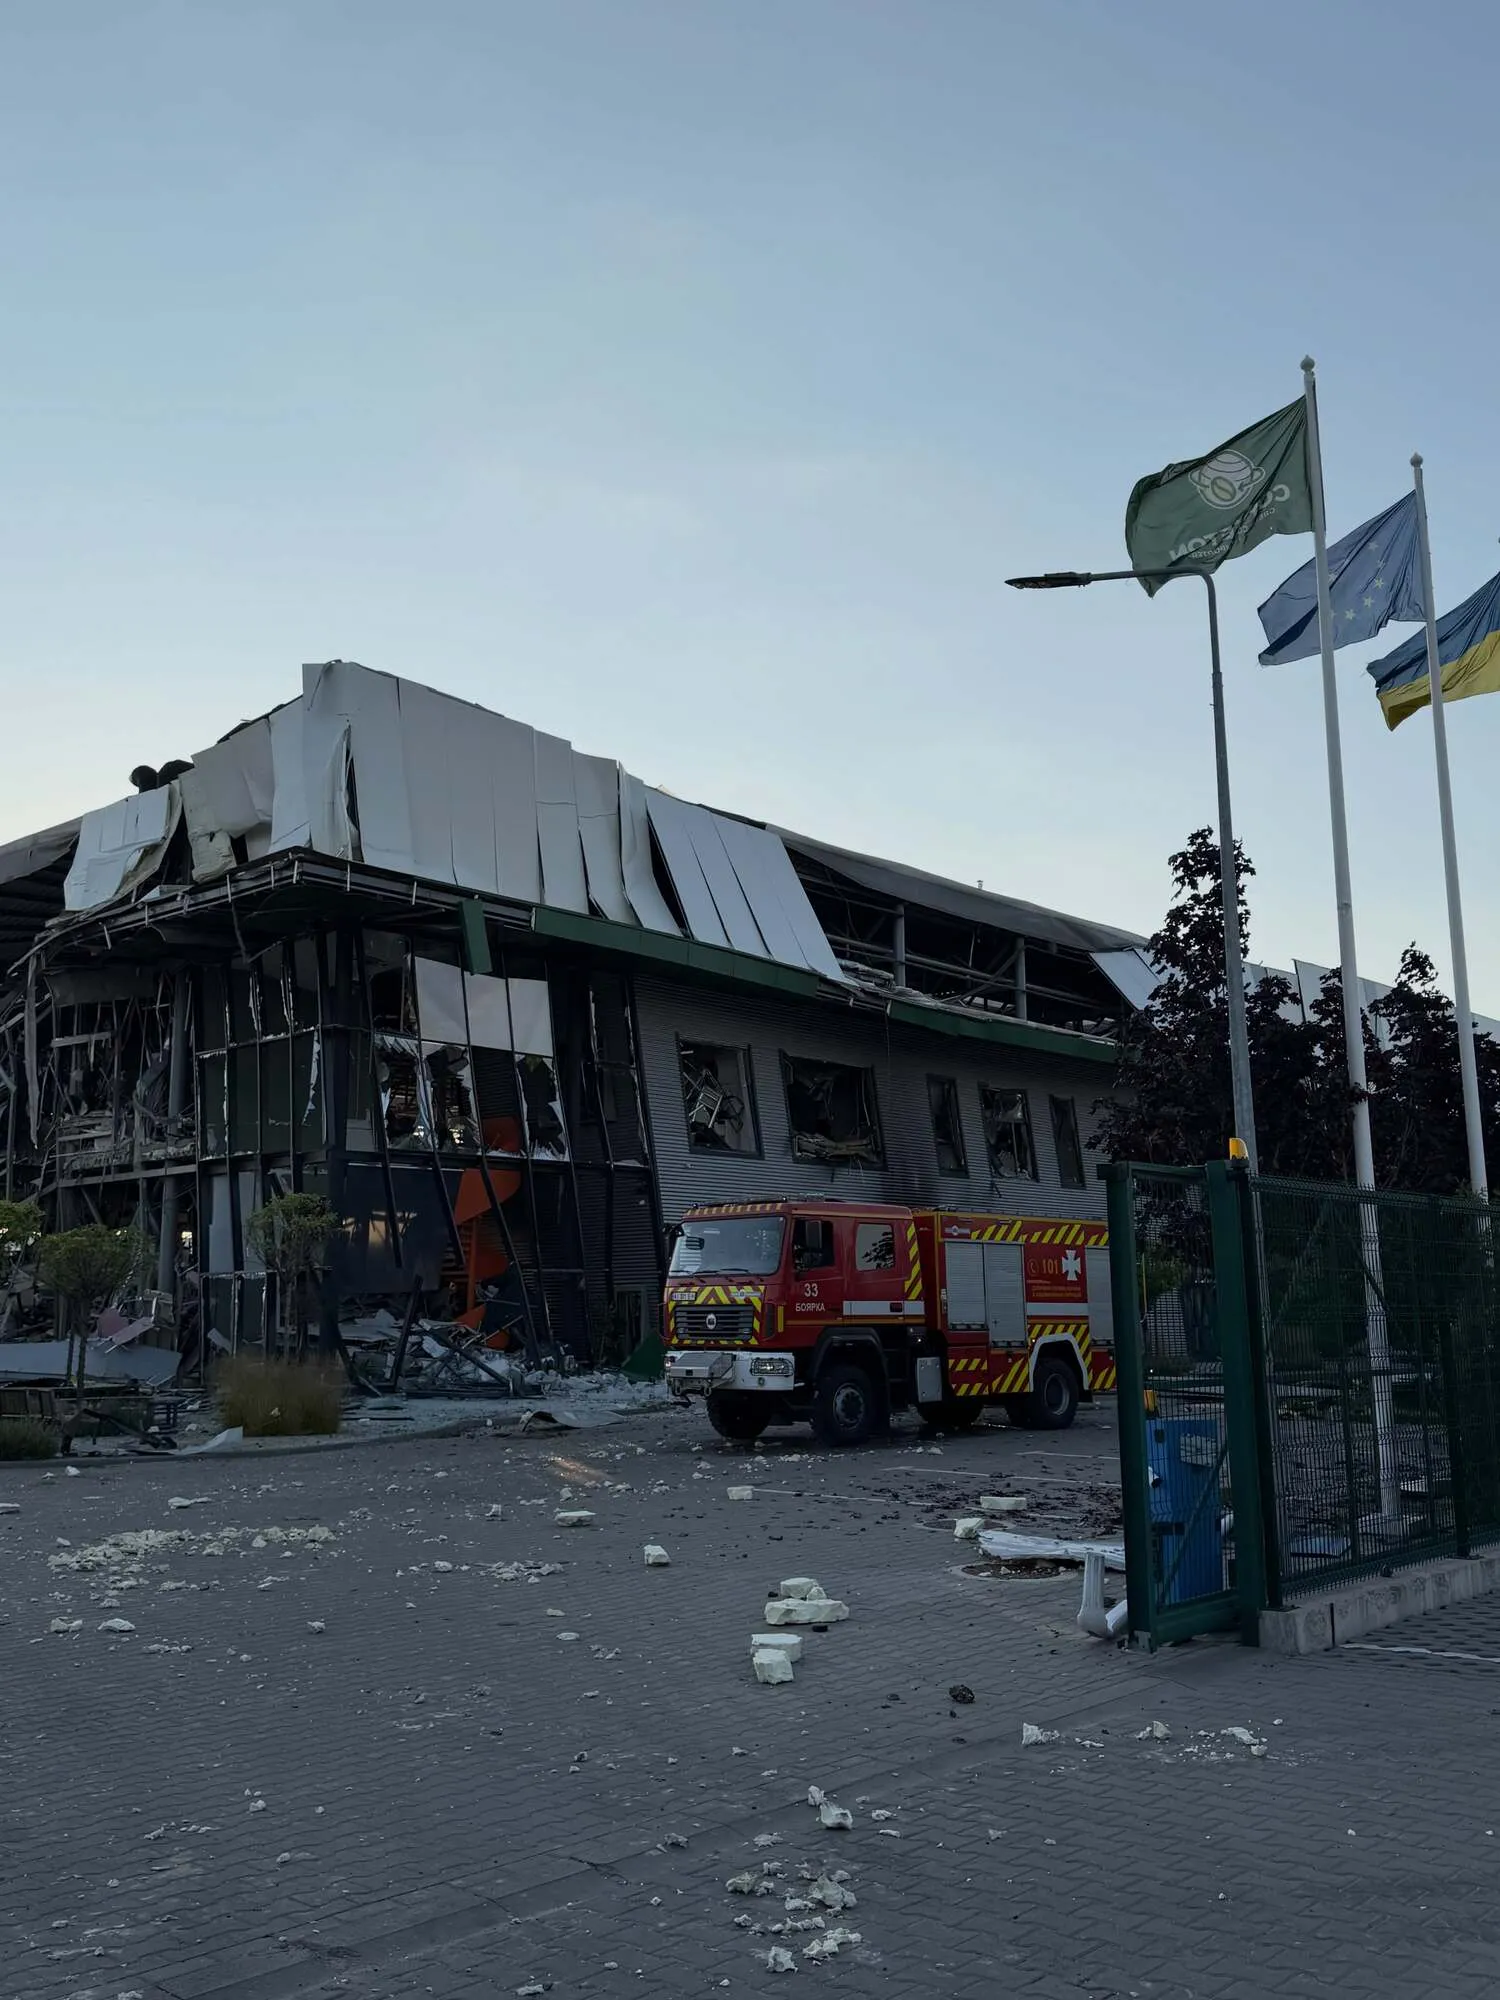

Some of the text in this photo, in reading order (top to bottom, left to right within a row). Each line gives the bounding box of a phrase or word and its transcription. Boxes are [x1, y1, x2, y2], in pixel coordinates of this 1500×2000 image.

[1042, 1259, 1058, 1274] 101
[804, 1283, 818, 1297] 33
[795, 1303, 825, 1312] БОЯРКА
